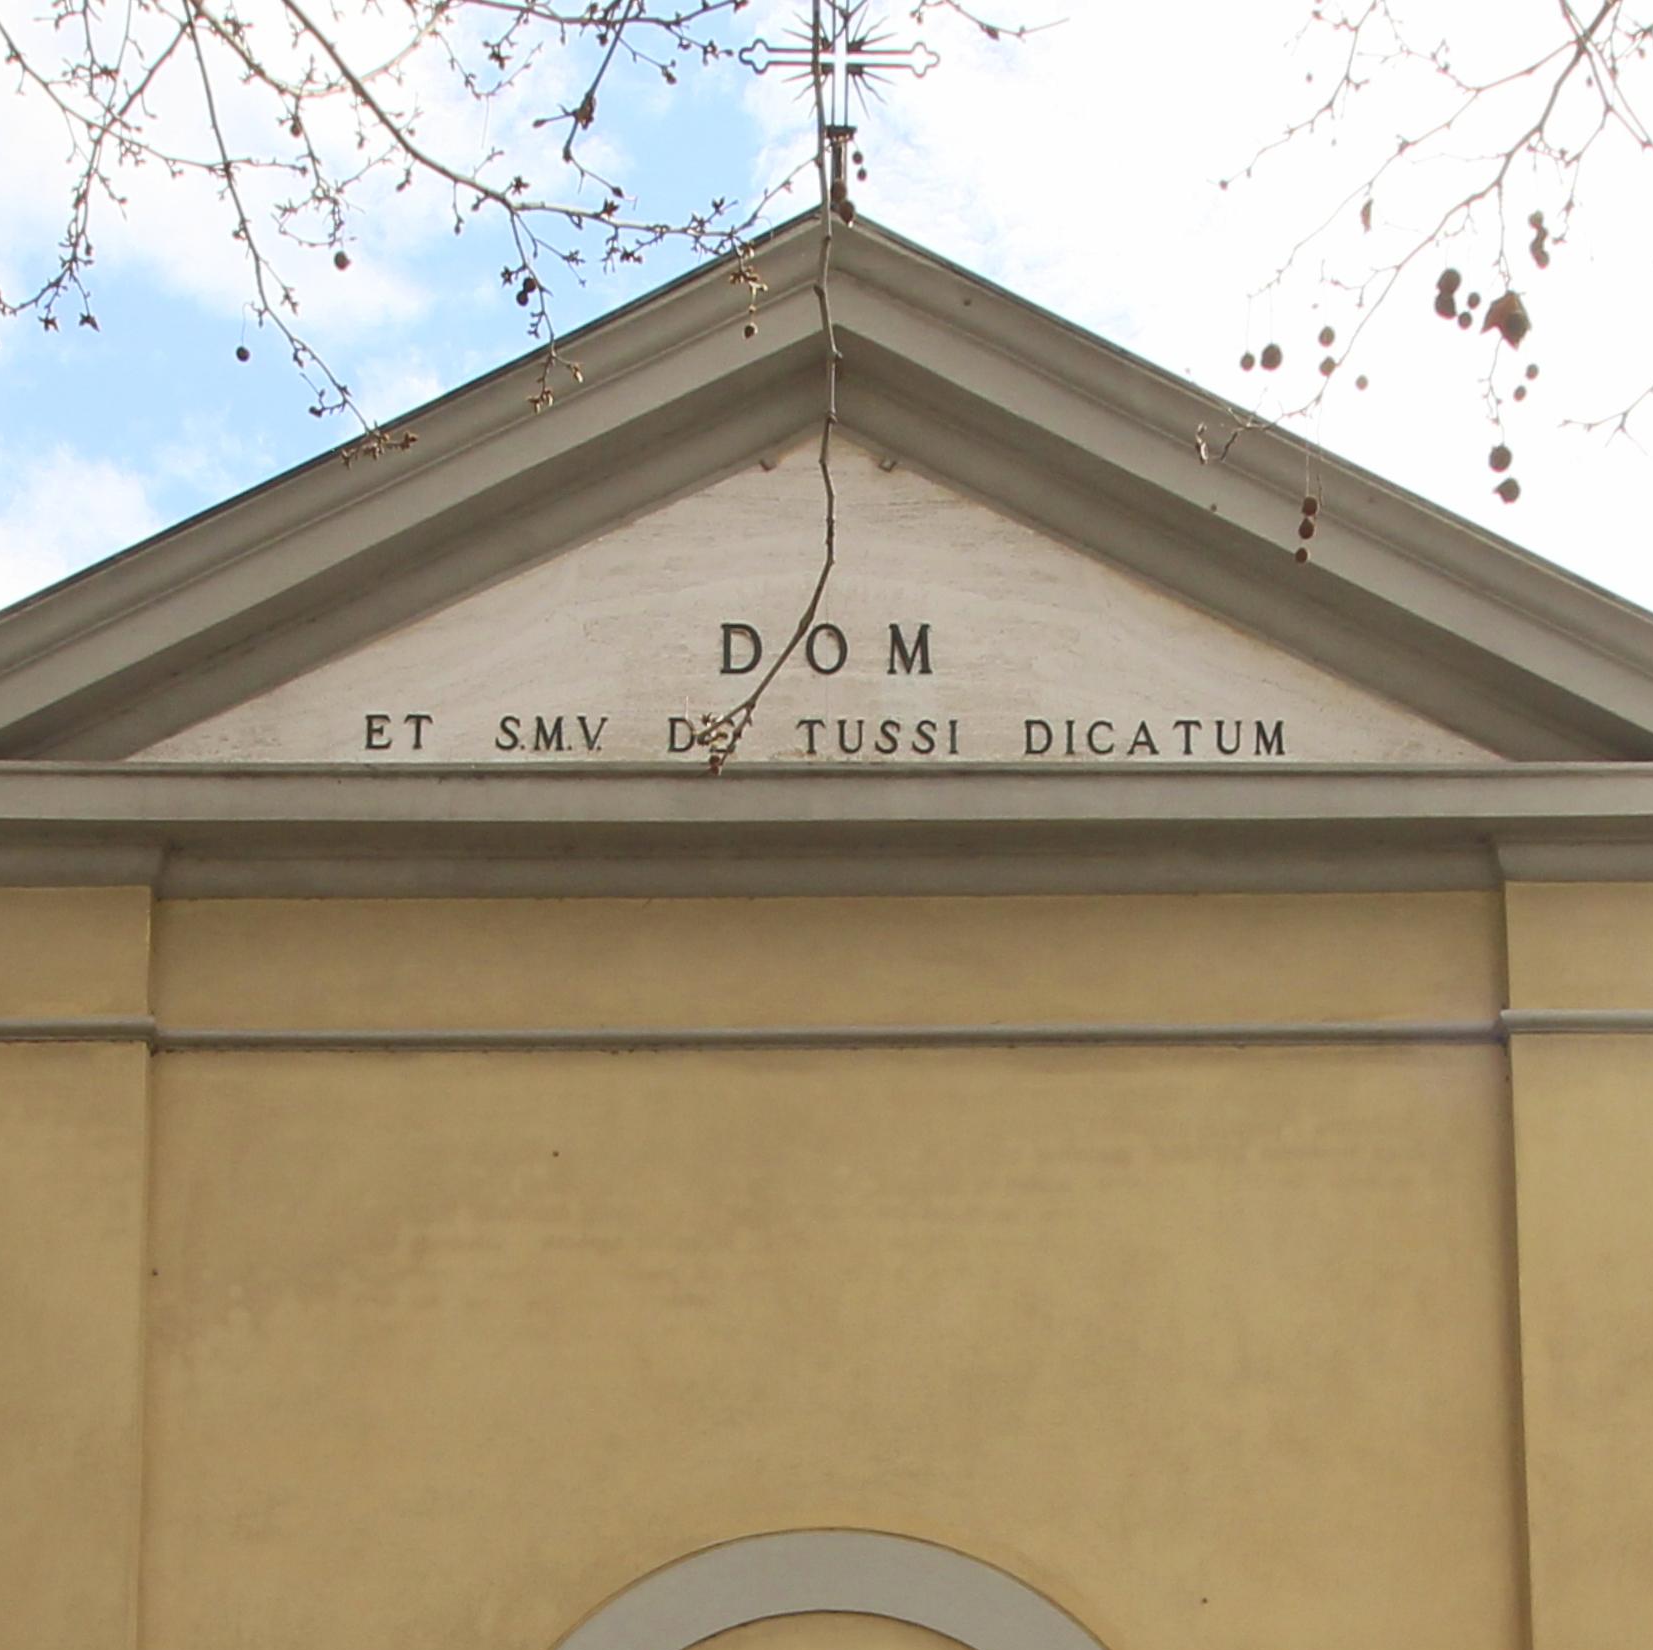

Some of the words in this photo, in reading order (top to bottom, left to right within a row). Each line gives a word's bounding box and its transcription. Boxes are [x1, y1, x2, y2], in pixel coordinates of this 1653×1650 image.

[363, 713, 432, 752] ET
[795, 717, 960, 757] TUSSI
[1024, 718, 1288, 758] DICATUM
